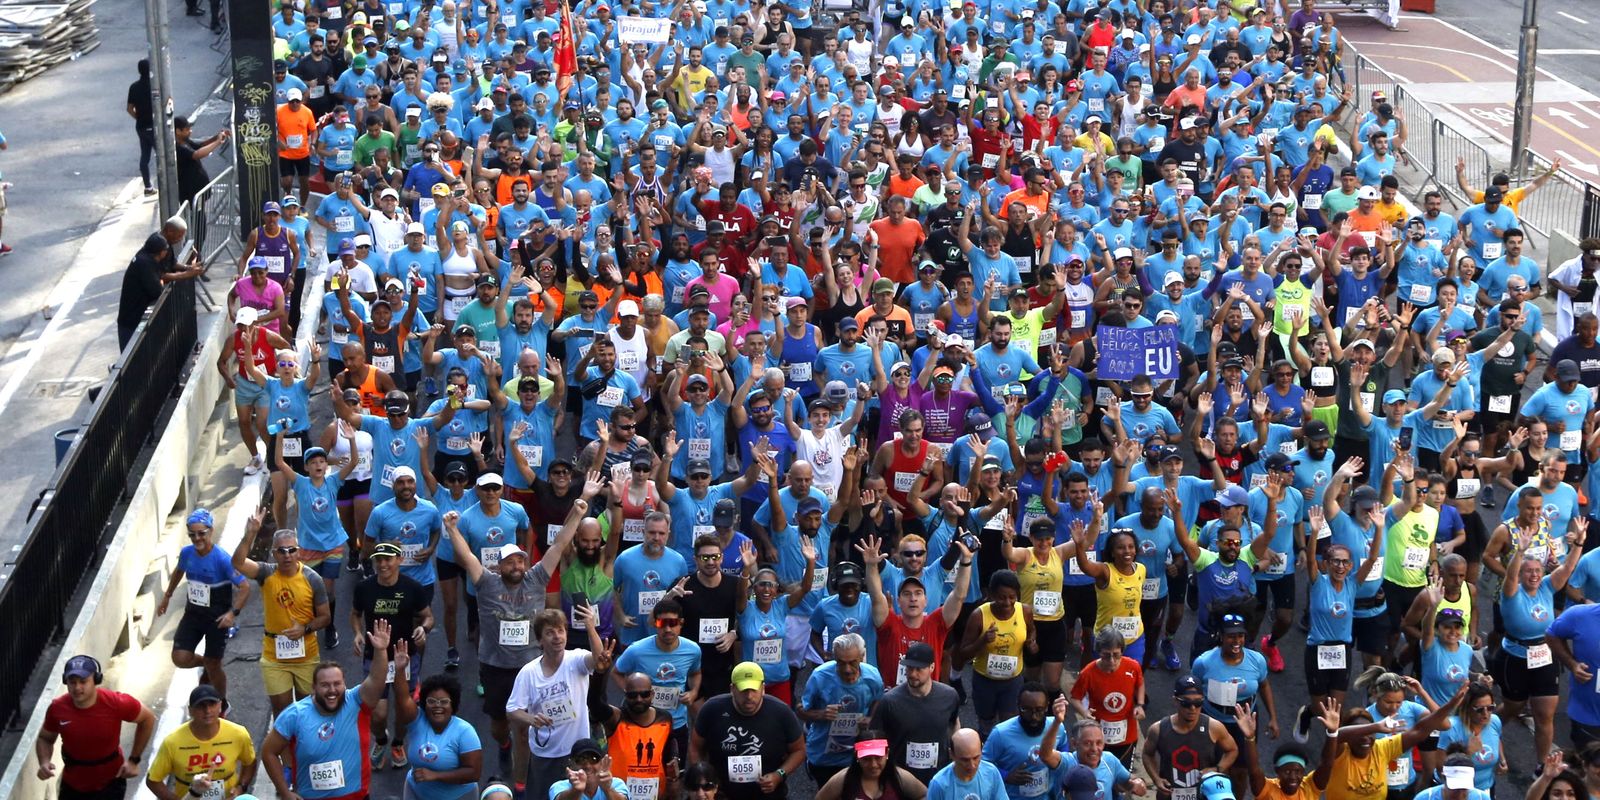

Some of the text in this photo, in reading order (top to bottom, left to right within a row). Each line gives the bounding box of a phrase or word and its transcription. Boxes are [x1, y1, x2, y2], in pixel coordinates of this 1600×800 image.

[622, 24, 656, 35] pirajui
[1102, 327, 1141, 341] HEITOR
[621, 356, 638, 365] 16284
[1145, 347, 1172, 377] EU
[792, 368, 806, 376] 9311
[896, 477, 914, 487] 1602
[1407, 553, 1423, 563] 6012
[1034, 597, 1057, 607] 26365
[502, 626, 524, 636] 17093
[703, 625, 721, 634] 4493
[277, 639, 299, 650] 11089
[755, 645, 778, 655] 10920
[1319, 650, 1341, 660] 12945
[989, 660, 1011, 672] 24496
[656, 692, 674, 702] 3861
[547, 704, 568, 718] 9541
[722, 742, 738, 751] MR
[910, 749, 931, 760] 3398
[312, 766, 339, 781] 25621
[733, 763, 754, 775] 5058
[628, 782, 653, 794] 11857
